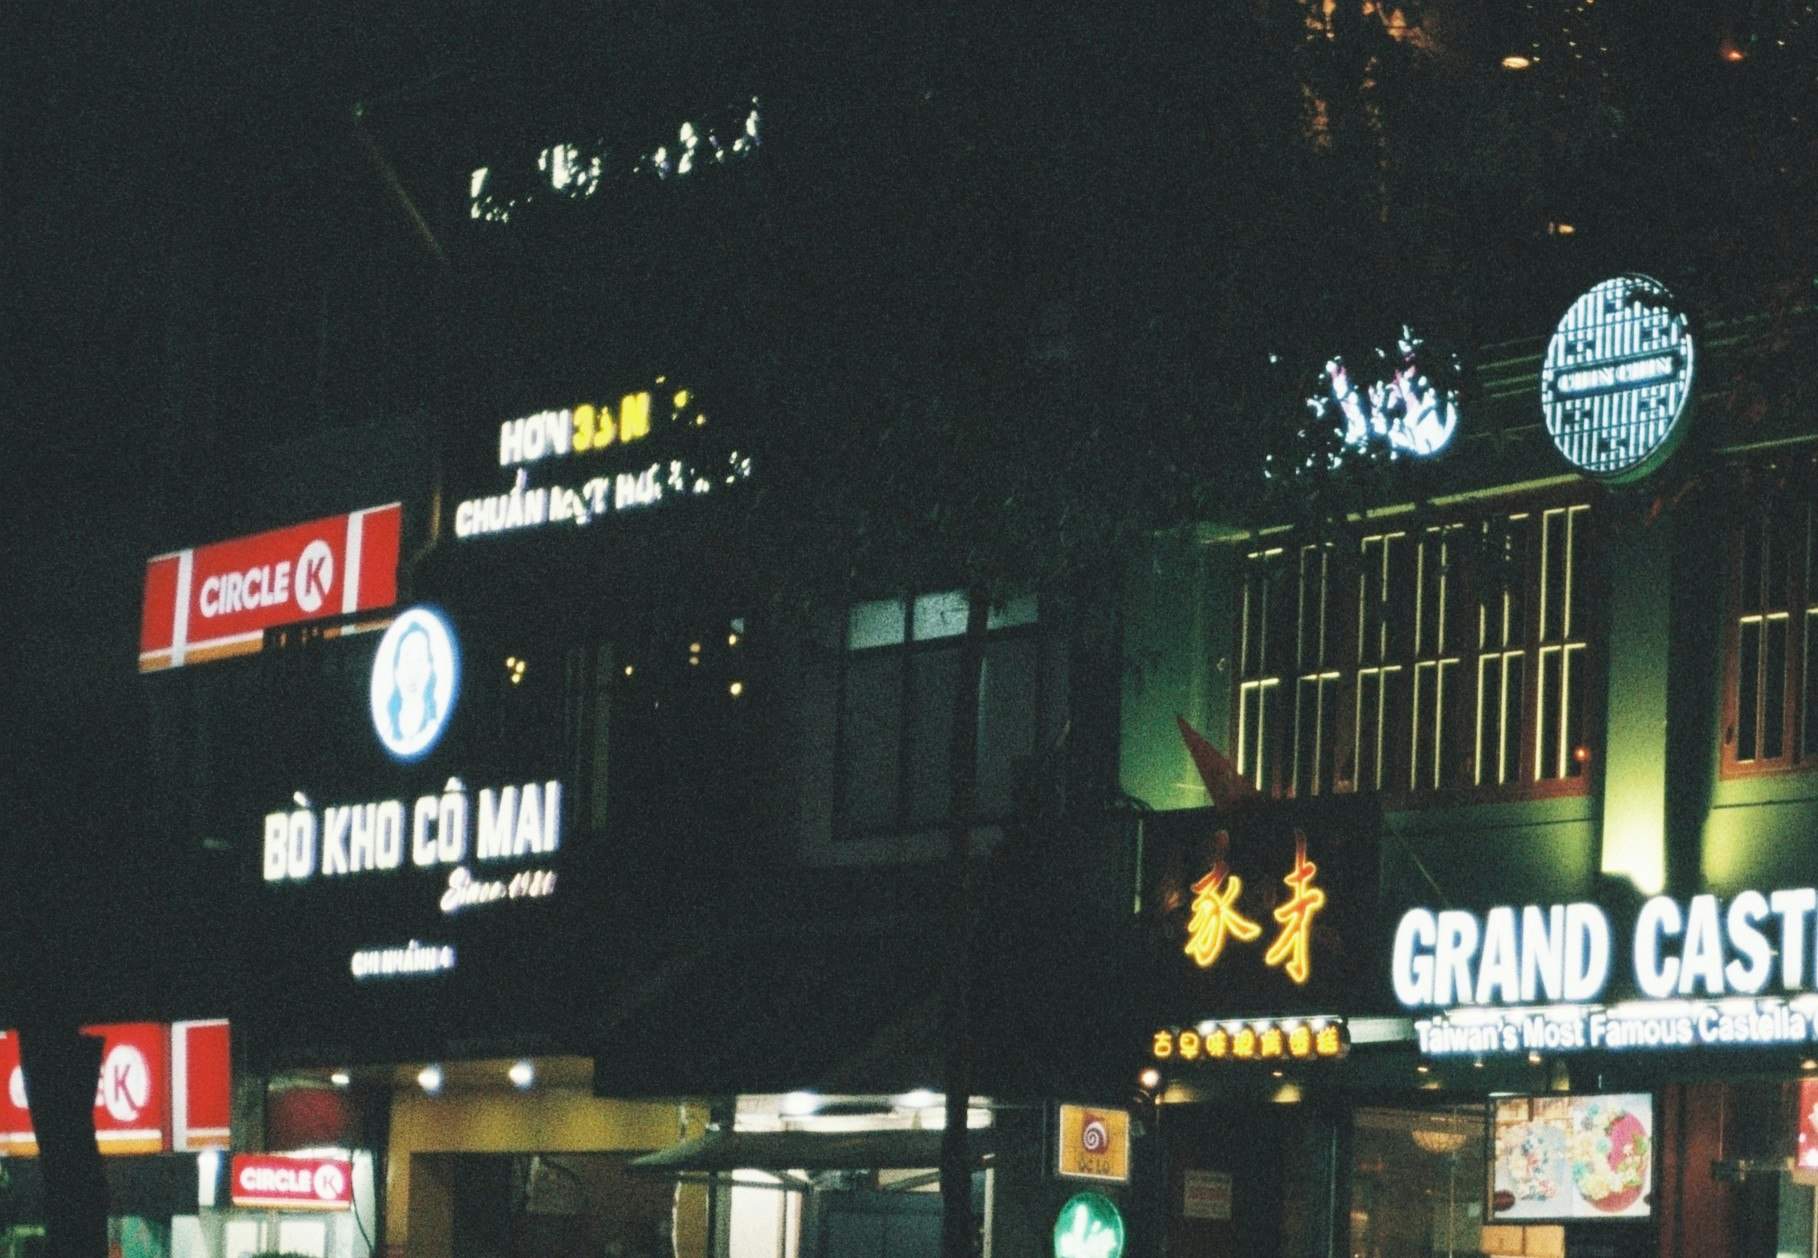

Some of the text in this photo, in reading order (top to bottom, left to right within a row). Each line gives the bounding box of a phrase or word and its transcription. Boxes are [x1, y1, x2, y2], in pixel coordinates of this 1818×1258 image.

[200, 550, 331, 617] CIRCLE K
[263, 776, 561, 880] BÒ KHO CÔ MAI
[1391, 901, 1611, 1005] GRAND
[1413, 1016, 1517, 1054] Taiwan's
[1521, 1014, 1584, 1049] Most
[1589, 1011, 1693, 1048] Famous
[1699, 1008, 1804, 1043] Castella
[240, 1167, 313, 1194] CIRCLE
